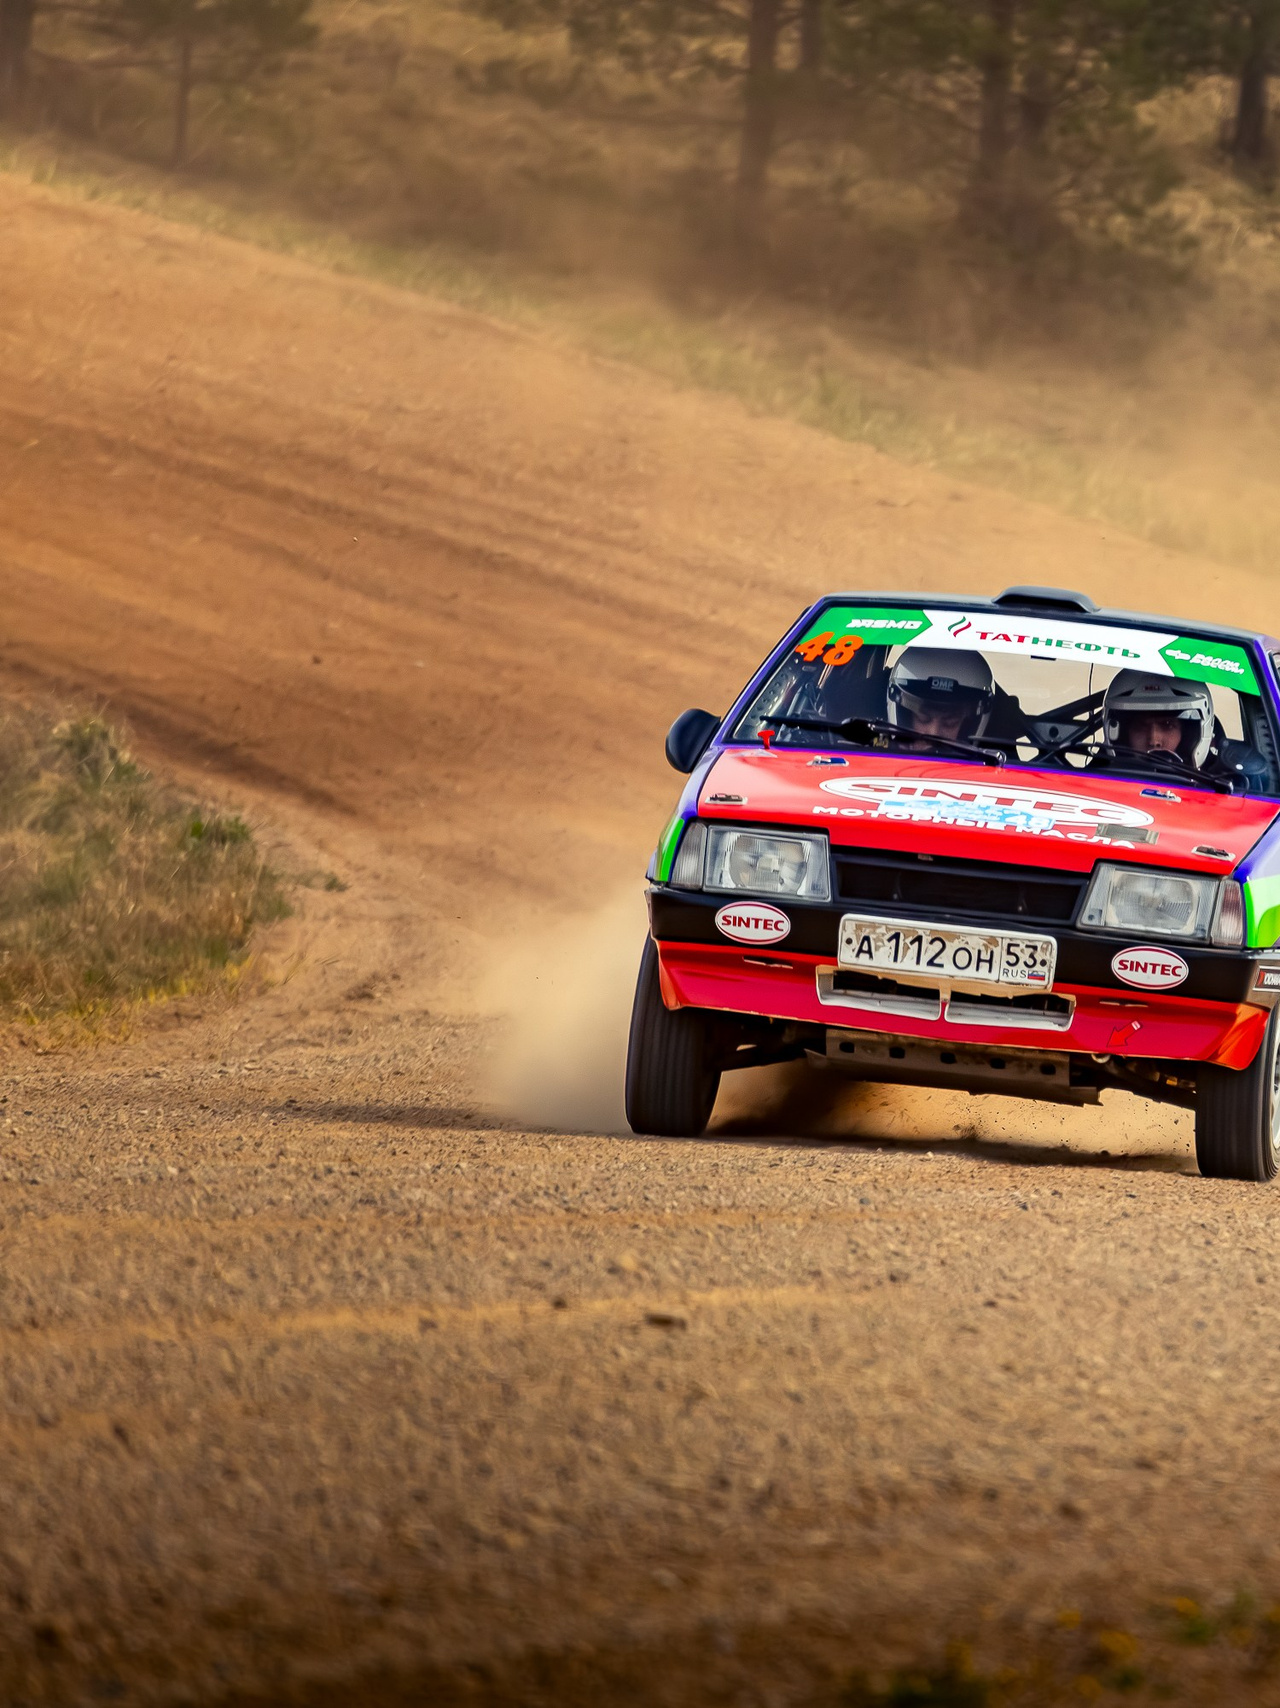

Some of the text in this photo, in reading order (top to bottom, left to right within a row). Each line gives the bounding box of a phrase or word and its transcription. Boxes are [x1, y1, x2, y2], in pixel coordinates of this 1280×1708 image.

[795, 631, 864, 666] 48
[975, 631, 1141, 659] ТАТНЕФТЬ
[931, 678, 954, 690] OMP
[848, 783, 1126, 821] SINTEC
[1015, 825, 1136, 849] МАСЛА
[721, 914, 785, 932] SINTEC
[1002, 968, 1026, 978] RUS
[1117, 959, 1183, 977] SINTEC
